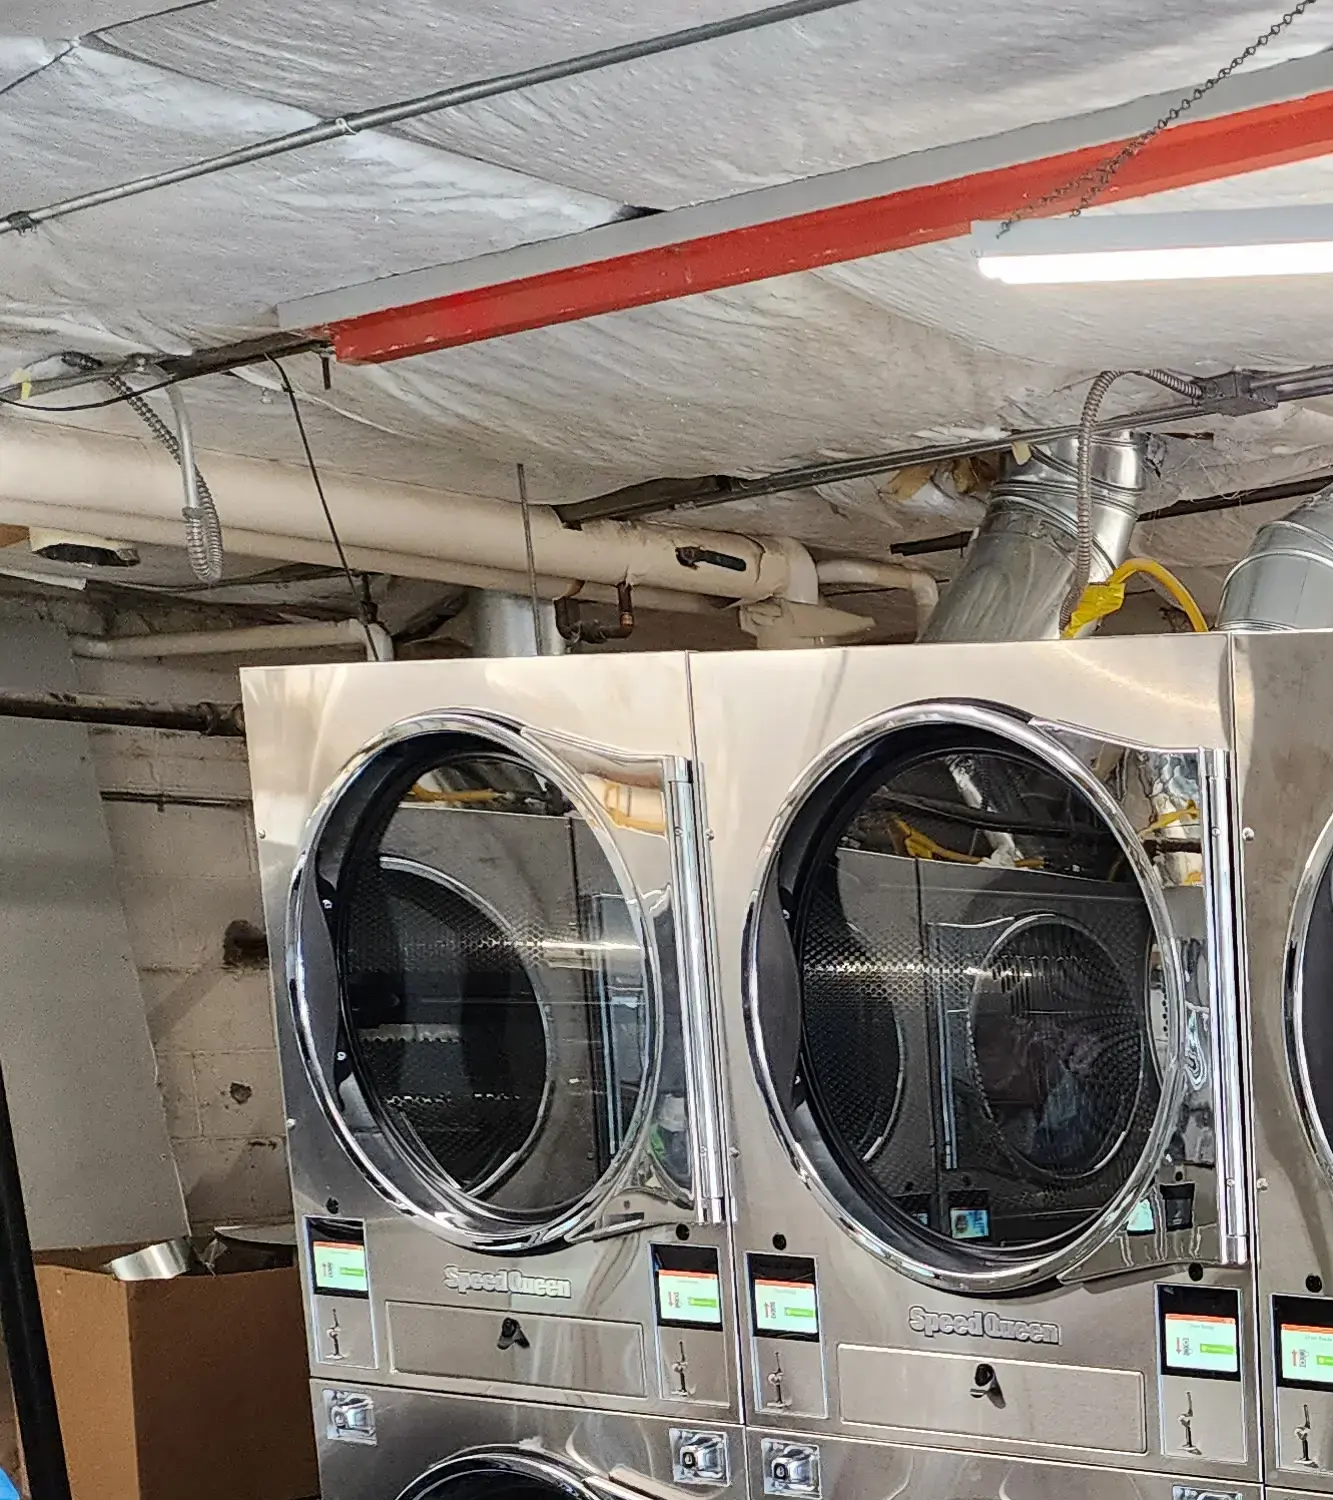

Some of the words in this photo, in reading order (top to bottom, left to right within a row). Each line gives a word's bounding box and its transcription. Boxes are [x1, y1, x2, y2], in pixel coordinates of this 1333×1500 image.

[443, 1264, 508, 1294] Speed
[508, 1269, 572, 1299] Queen
[909, 1306, 984, 1338] Speed
[984, 1312, 1062, 1345] Queen
